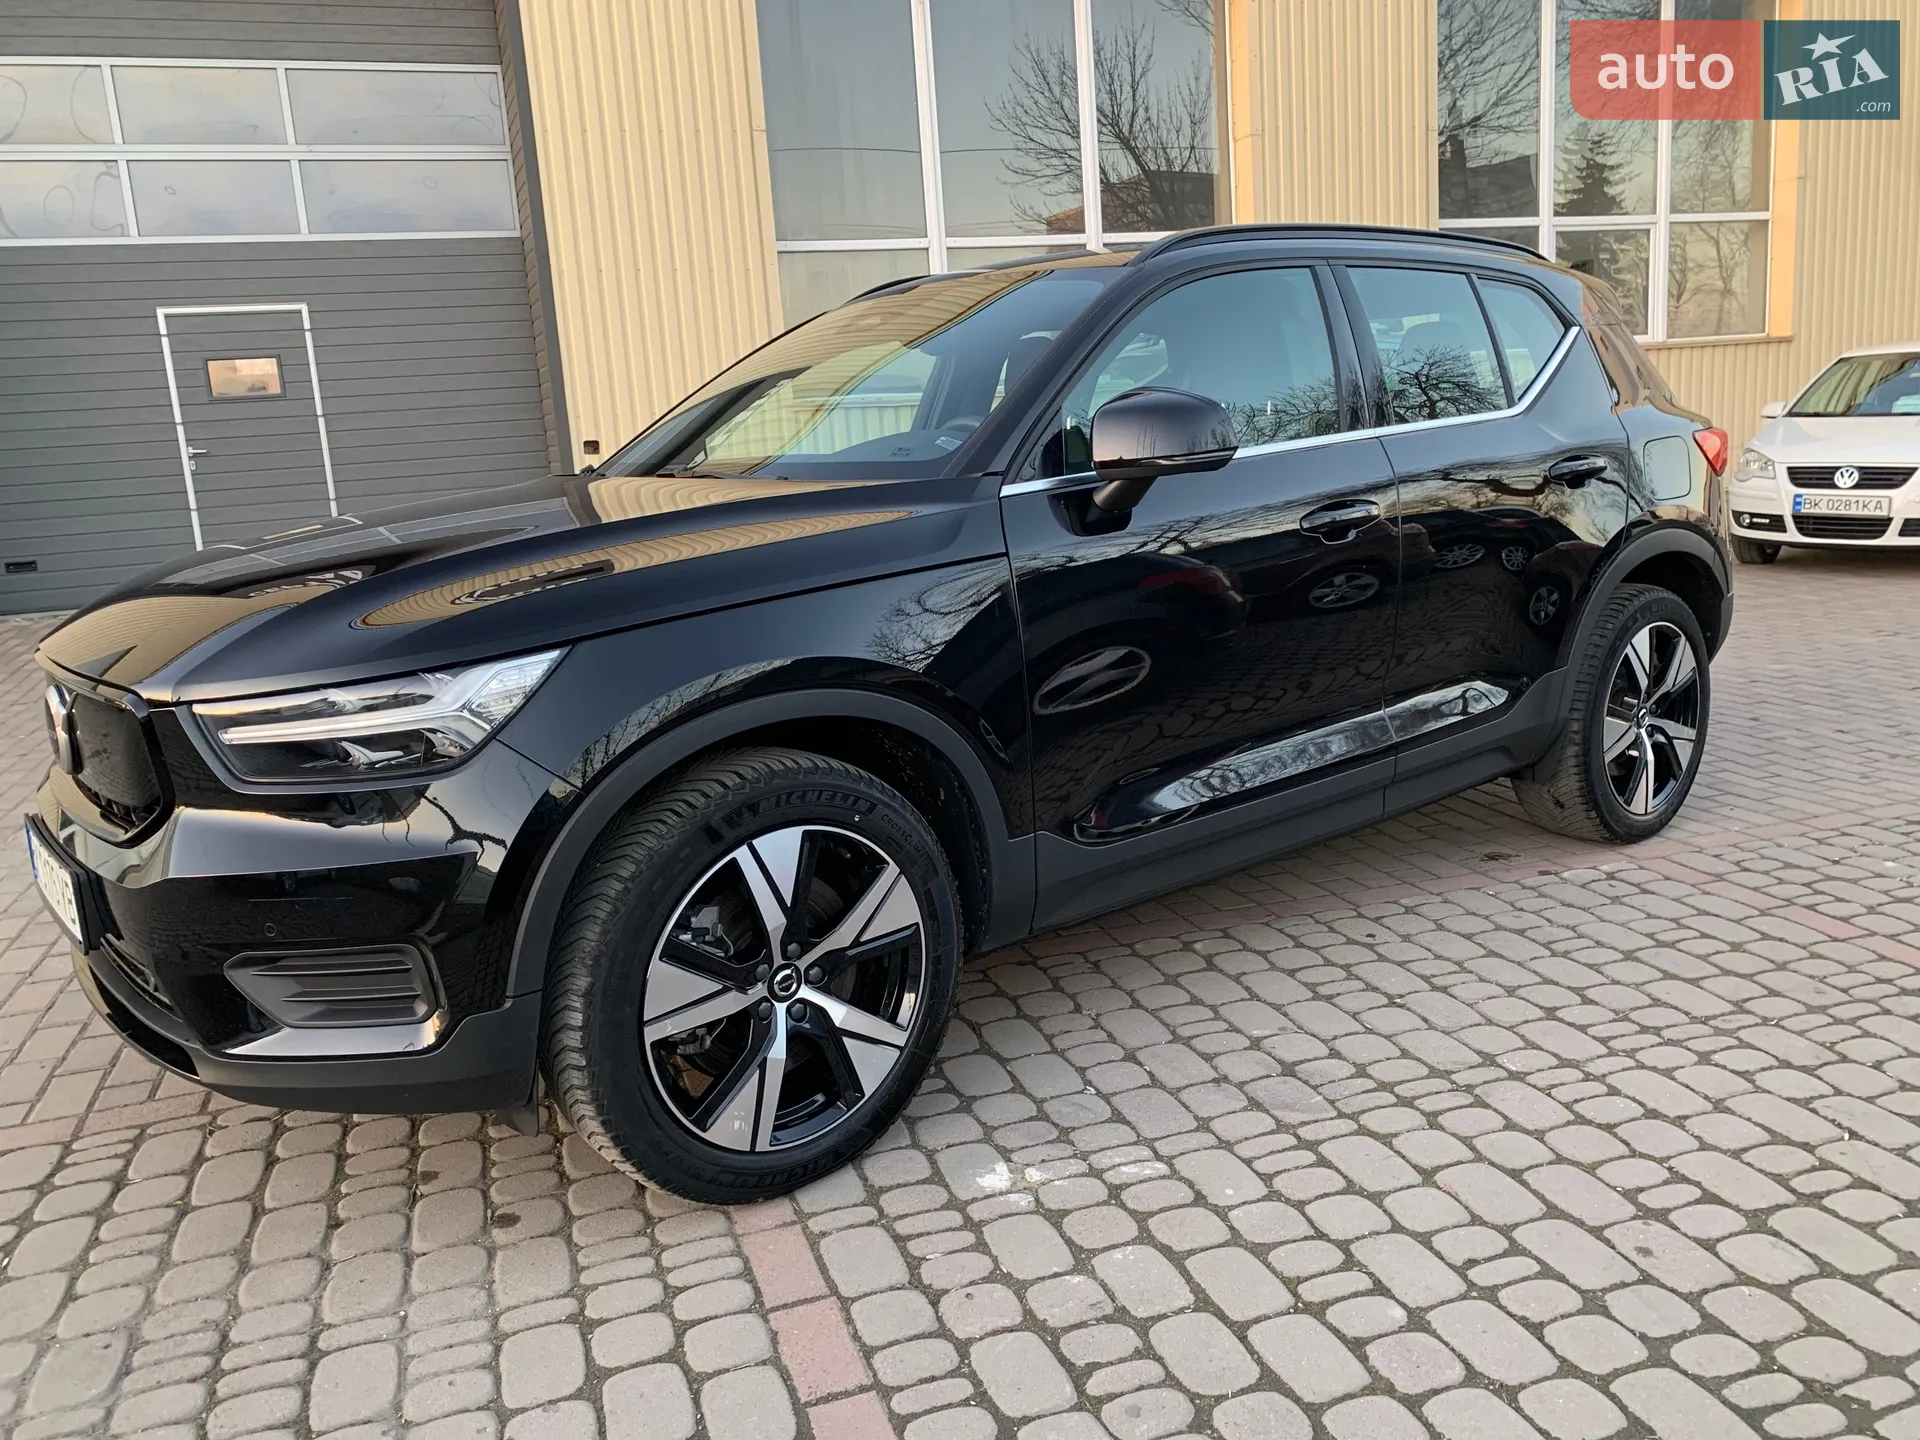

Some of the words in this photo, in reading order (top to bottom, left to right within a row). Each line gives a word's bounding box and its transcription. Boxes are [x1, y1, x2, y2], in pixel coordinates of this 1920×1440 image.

[1803, 498, 1823, 511] BK
[1826, 498, 1860, 512] 0281
[1862, 499, 1884, 513] KA
[757, 790, 871, 815] MICHELIN
